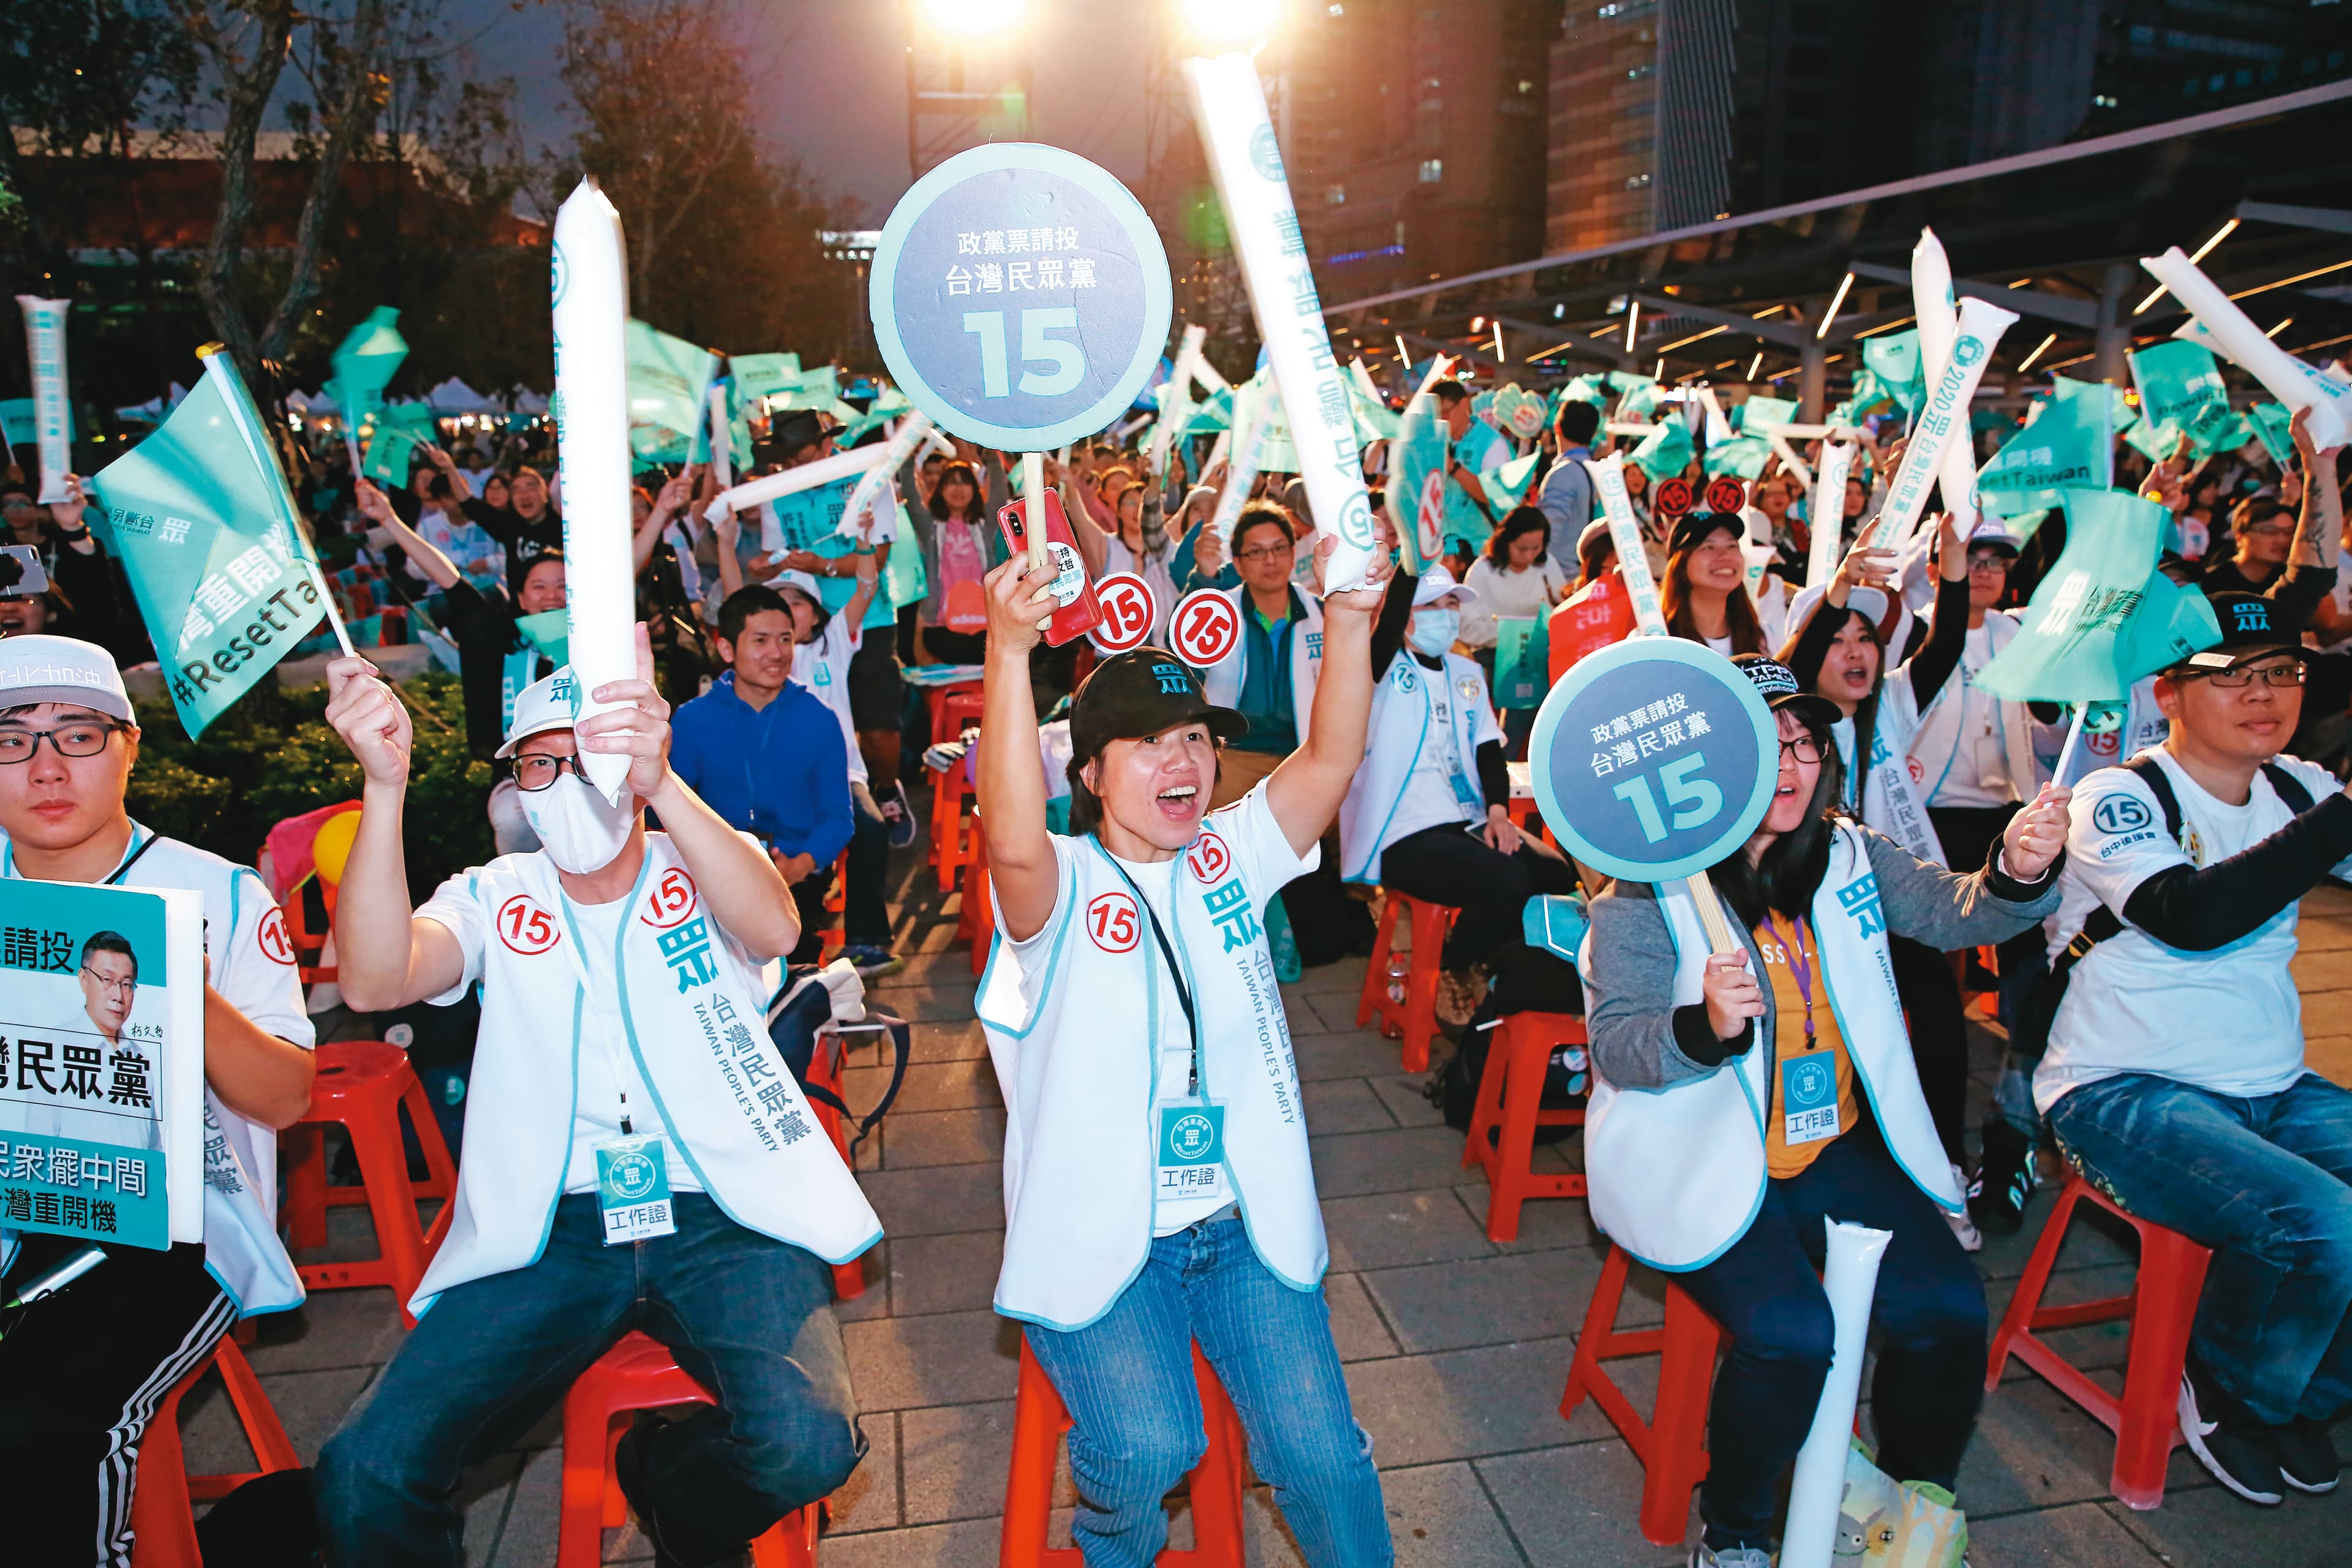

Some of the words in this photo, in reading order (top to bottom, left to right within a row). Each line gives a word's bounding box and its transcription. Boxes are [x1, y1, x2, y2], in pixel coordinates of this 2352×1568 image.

[957, 226, 1079, 256] 政黨票請投
[945, 257, 1098, 296] 台灣民眾黨
[963, 306, 1087, 398] 15
[1934, 366, 1966, 412] 2020
[1605, 475, 1620, 489] 15
[1664, 483, 1687, 509] 15
[1715, 484, 1738, 510] 15
[1057, 547, 1070, 559] 持
[1102, 589, 1141, 640] 15
[1180, 606, 1228, 654] 15
[2233, 603, 2271, 631] 眾
[0, 663, 101, 685] 北加油
[1151, 663, 1193, 695] 眾
[1591, 692, 1689, 744] 政黨票請投
[1591, 711, 1712, 777] 台灣民眾黨
[1612, 751, 1723, 844] 15
[2099, 801, 2143, 827] 15
[1188, 837, 1224, 878] 15
[650, 873, 687, 923] 15
[1202, 877, 1263, 954] 眾
[1836, 872, 1887, 941] 眾
[506, 903, 553, 945] 15
[1091, 902, 1137, 944] 15
[0, 926, 74, 973] 請投
[657, 916, 720, 995] 眾
[132, 1022, 164, 1038] 柯文哲
[1237, 958, 1264, 1013] TAIWAN
[1257, 1017, 1280, 1077] PEOPLE'S
[1273, 1082, 1295, 1123] PARTY
[693, 1001, 723, 1056] TAIWAN
[718, 1059, 755, 1115] PEOPLE'S
[751, 1118, 780, 1152] PARTY
[712, 993, 812, 1145] 台灣民眾黨
[1185, 1129, 1200, 1146] 眾
[1790, 1109, 1835, 1133] 工作證
[624, 1167, 641, 1186] 眾
[1161, 1167, 1215, 1187] 工作證
[0, 1188, 116, 1234] 灣重開機
[609, 1204, 668, 1230] 工作證
